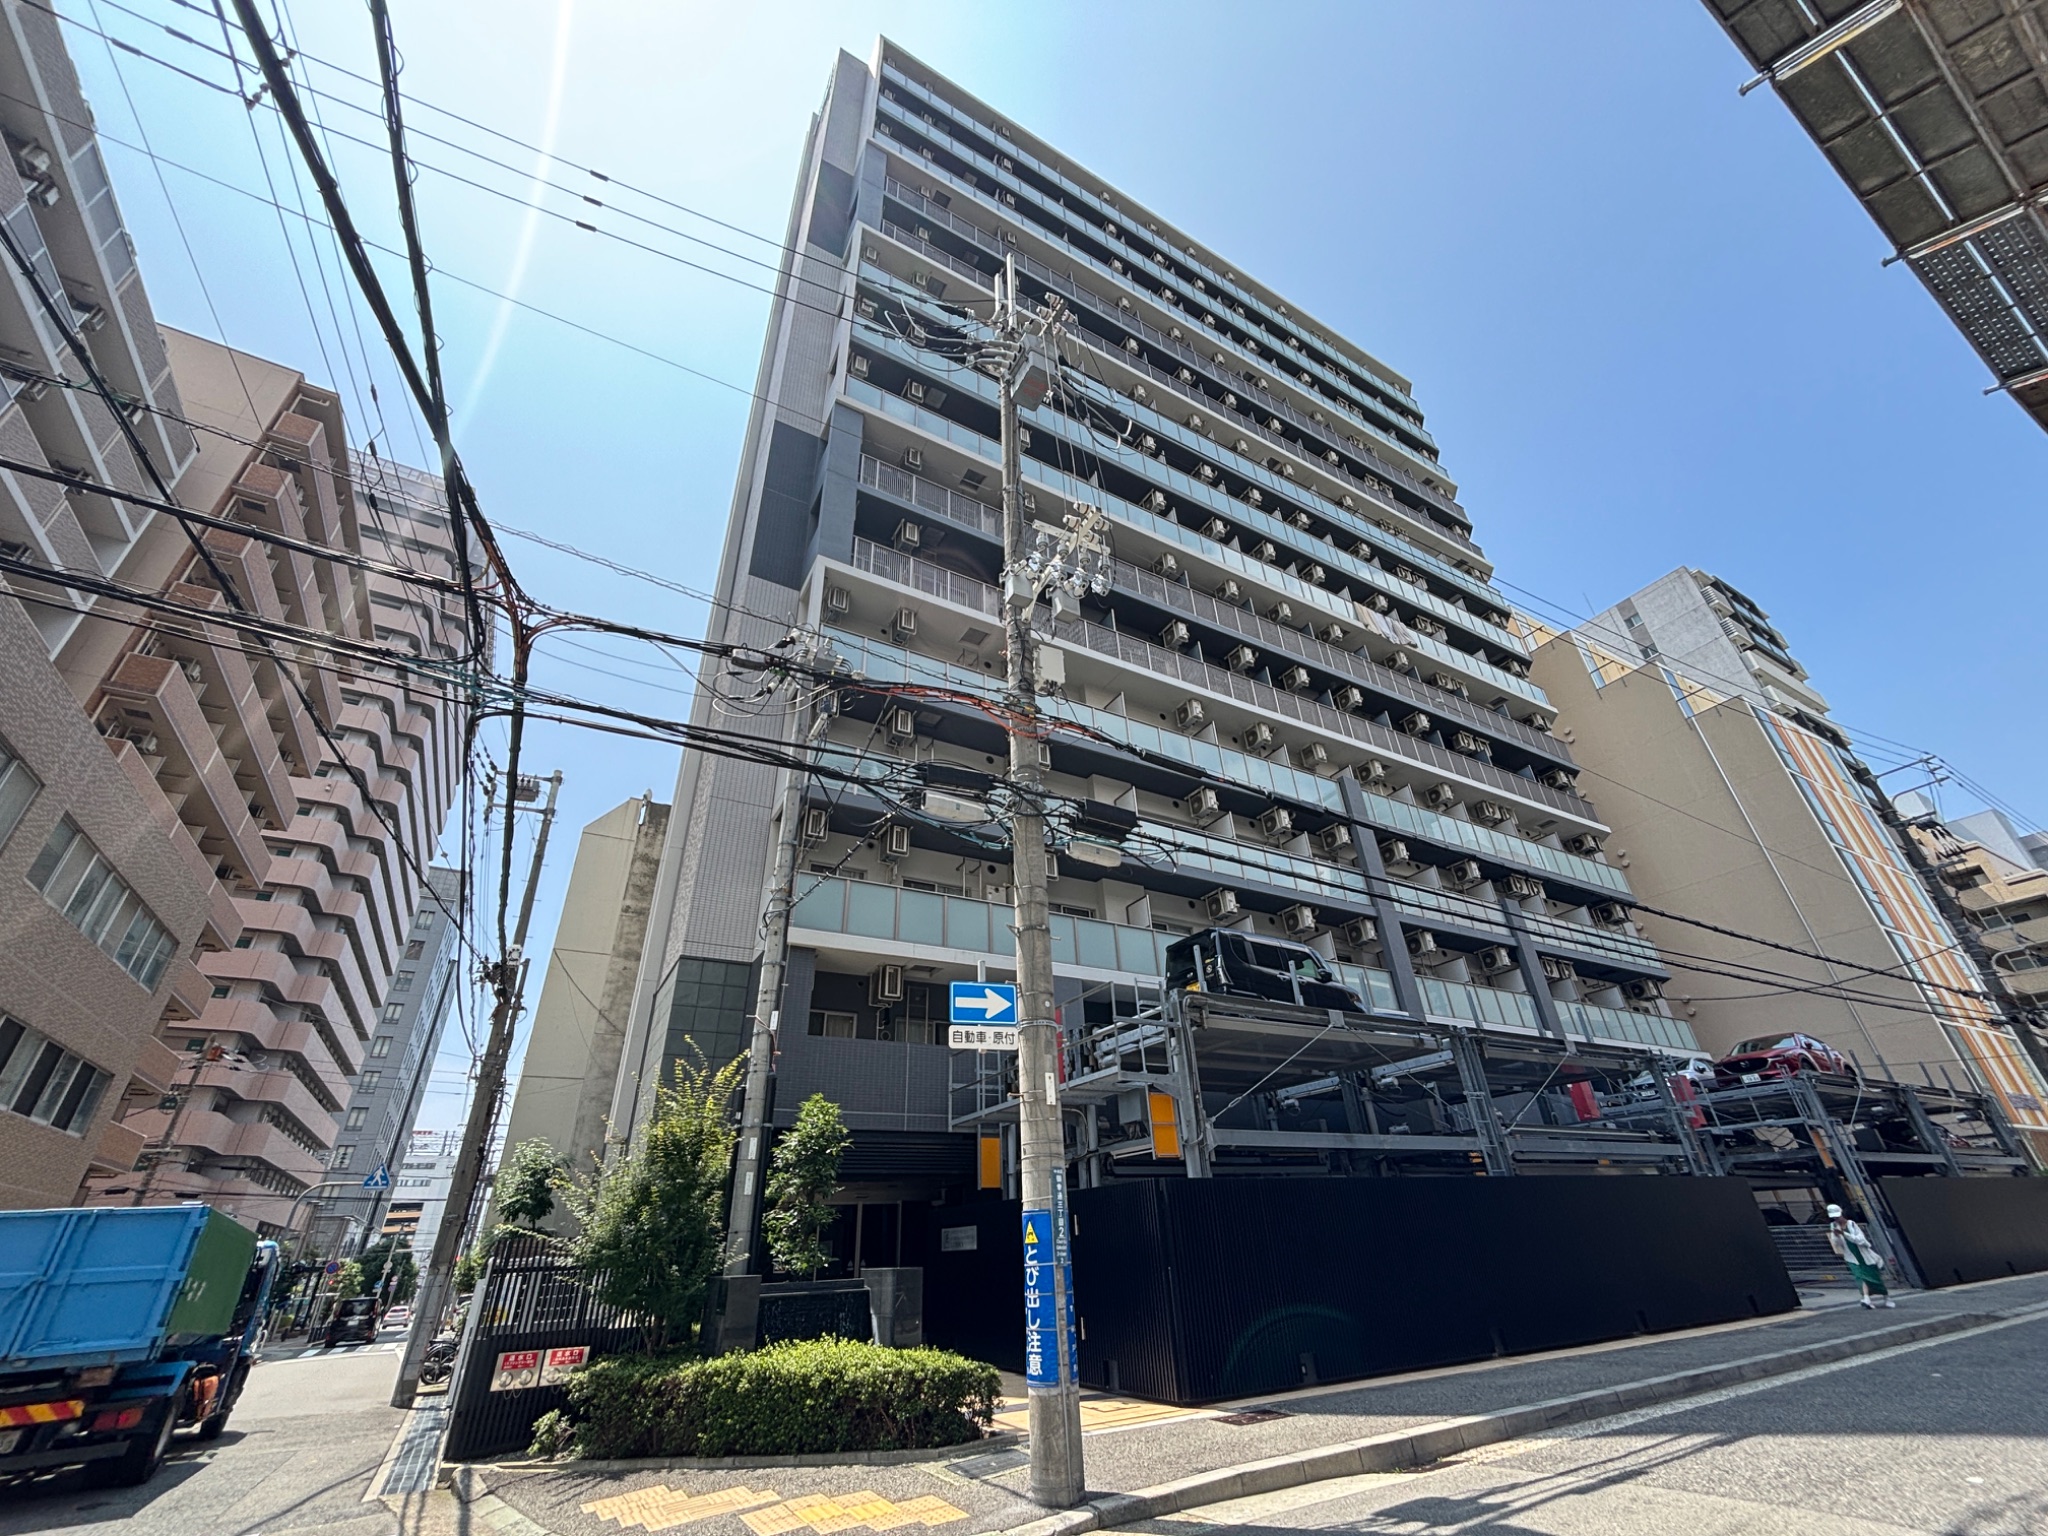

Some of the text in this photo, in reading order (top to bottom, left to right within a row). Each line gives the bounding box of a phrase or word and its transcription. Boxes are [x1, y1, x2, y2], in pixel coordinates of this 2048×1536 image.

[952, 1030, 1015, 1045] 自動車・原付
[1025, 1246, 1043, 1376] とび出し注意
